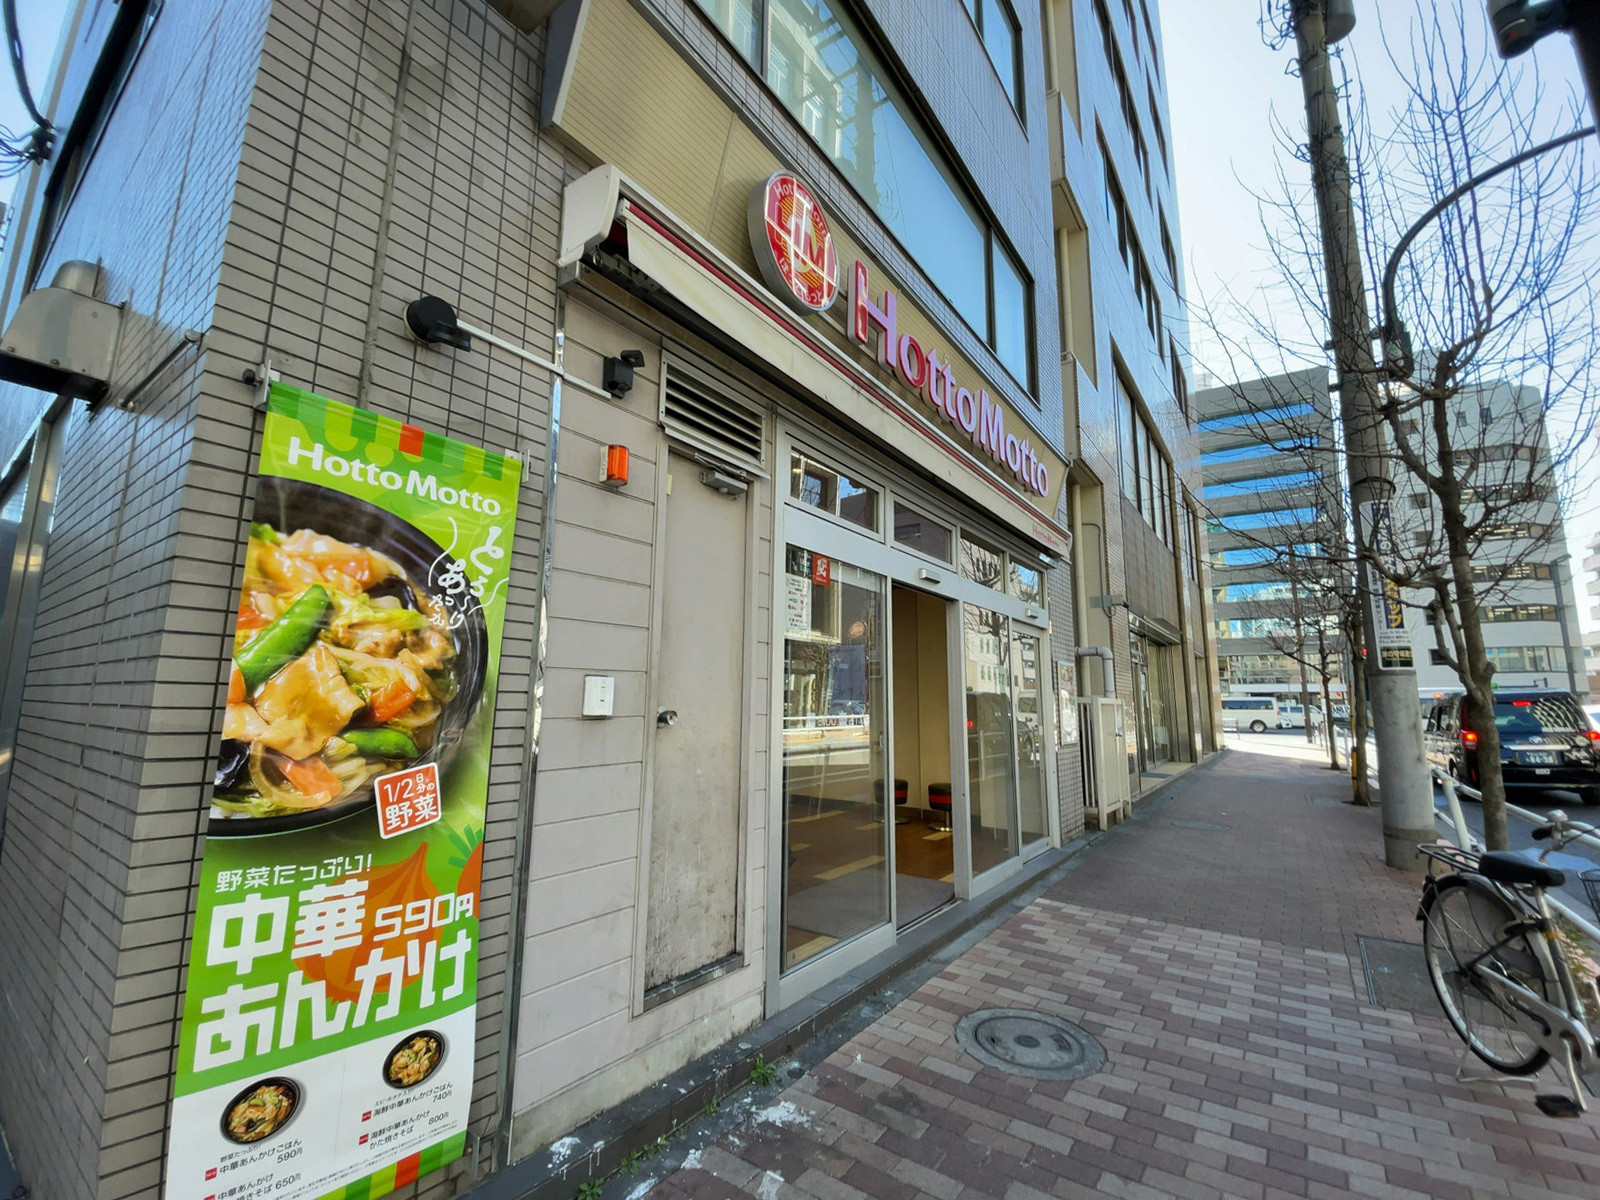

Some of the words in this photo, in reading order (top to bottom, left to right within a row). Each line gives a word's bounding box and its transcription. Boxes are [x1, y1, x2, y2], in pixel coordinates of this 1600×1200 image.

[385, 793, 438, 831] 野菜
[205, 879, 369, 976] 中華
[372, 892, 475, 942] 590円
[191, 929, 473, 1073] あんかけ
[369, 1125, 415, 1150] かた焼きそば
[219, 1138, 303, 1174] 中華あんかけごはん
[276, 1146, 304, 1164] 590円
[217, 1173, 275, 1199] 中華あんかけ
[275, 1172, 302, 1190] 650円
